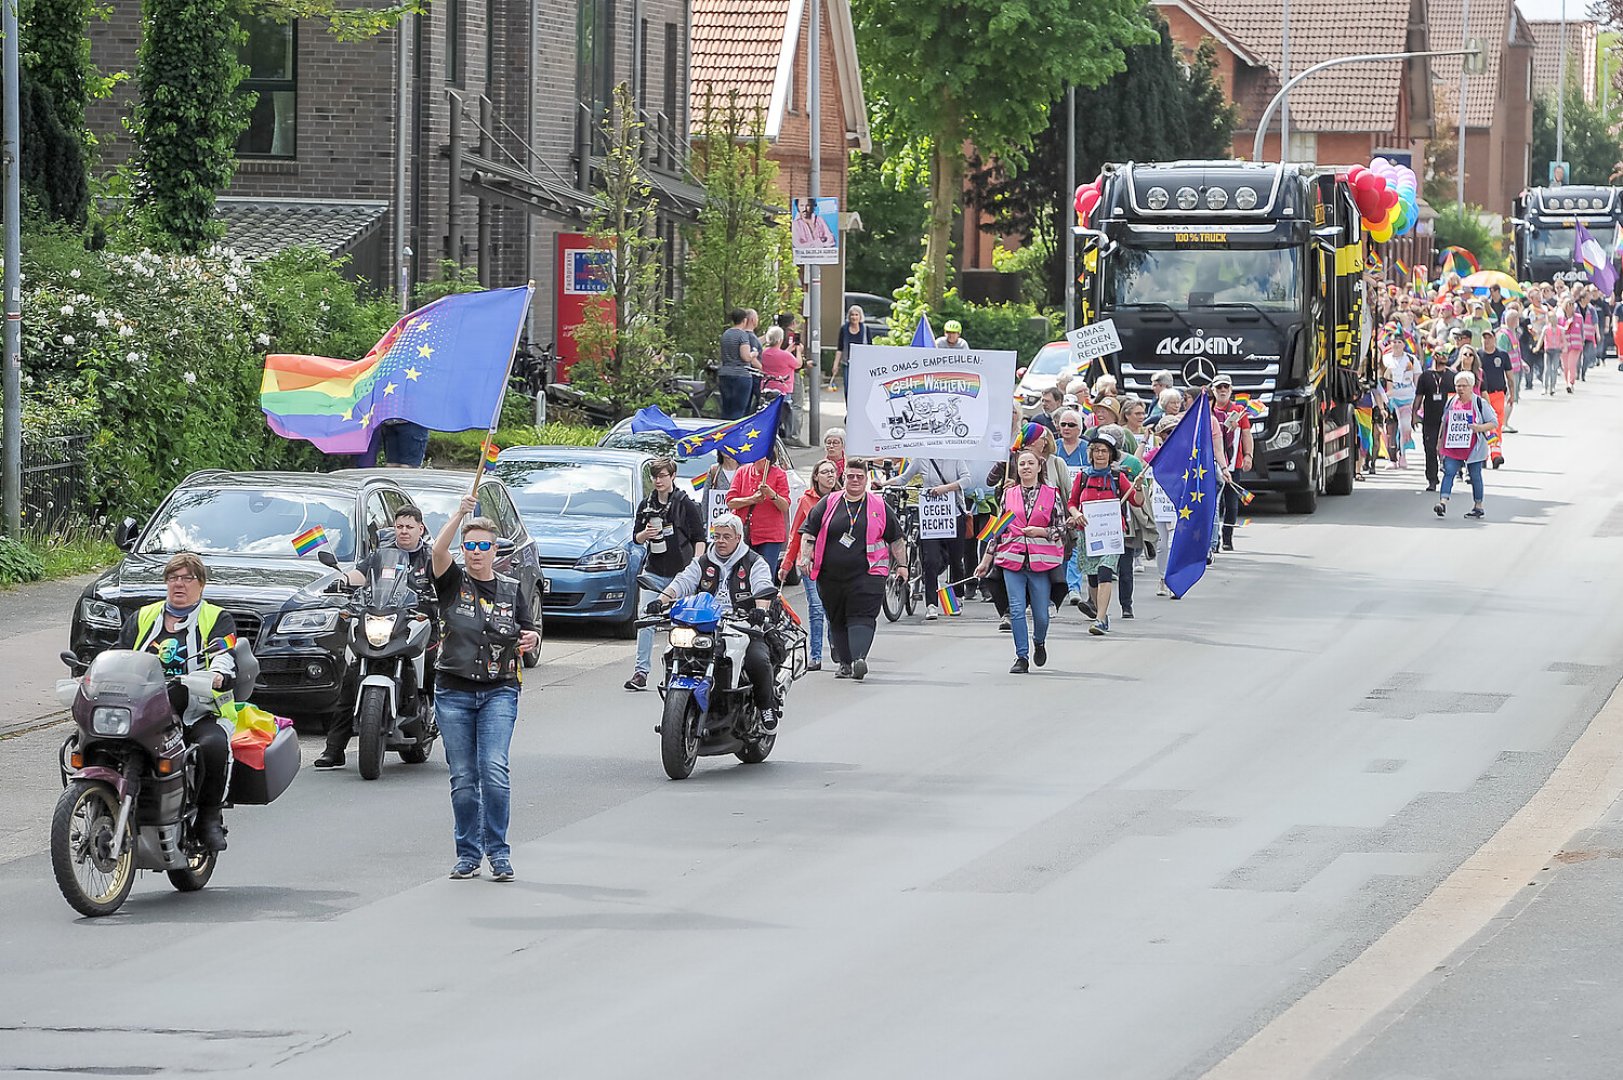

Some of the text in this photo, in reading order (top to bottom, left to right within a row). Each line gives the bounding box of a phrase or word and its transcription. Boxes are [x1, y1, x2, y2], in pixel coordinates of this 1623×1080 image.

[1200, 233, 1227, 243] TRUCK
[1076, 325, 1105, 340] OMAS
[1076, 333, 1111, 350] GEGEN
[1077, 341, 1117, 360] RECHTS
[869, 355, 984, 377] WIR OMAS EMPFEHLEN:
[1448, 433, 1471, 442] RECHTS
[923, 504, 952, 516] GEGEN
[922, 517, 954, 531] RECHTS
